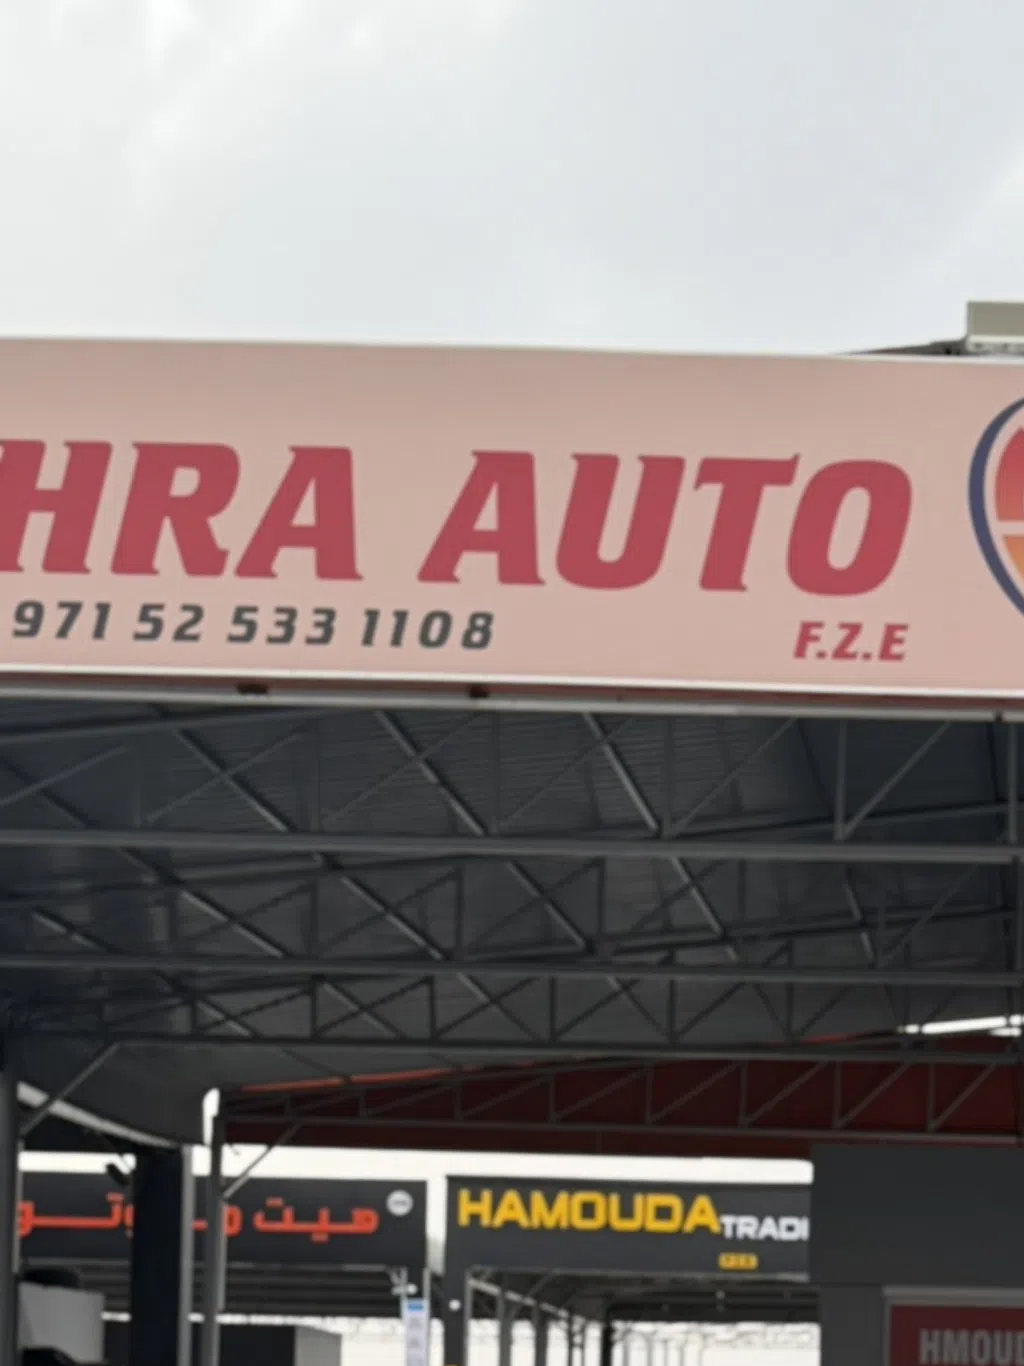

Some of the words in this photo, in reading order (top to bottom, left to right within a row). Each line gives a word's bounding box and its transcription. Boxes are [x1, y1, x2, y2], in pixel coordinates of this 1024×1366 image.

[416, 449, 912, 597] AUTO
[12, 600, 112, 640] 971
[133, 603, 205, 642] 52
[227, 606, 337, 645] 533
[360, 609, 495, 650] 1108
[793, 621, 909, 662] F.Z.E
[458, 1187, 721, 1234] HAMOUDA
